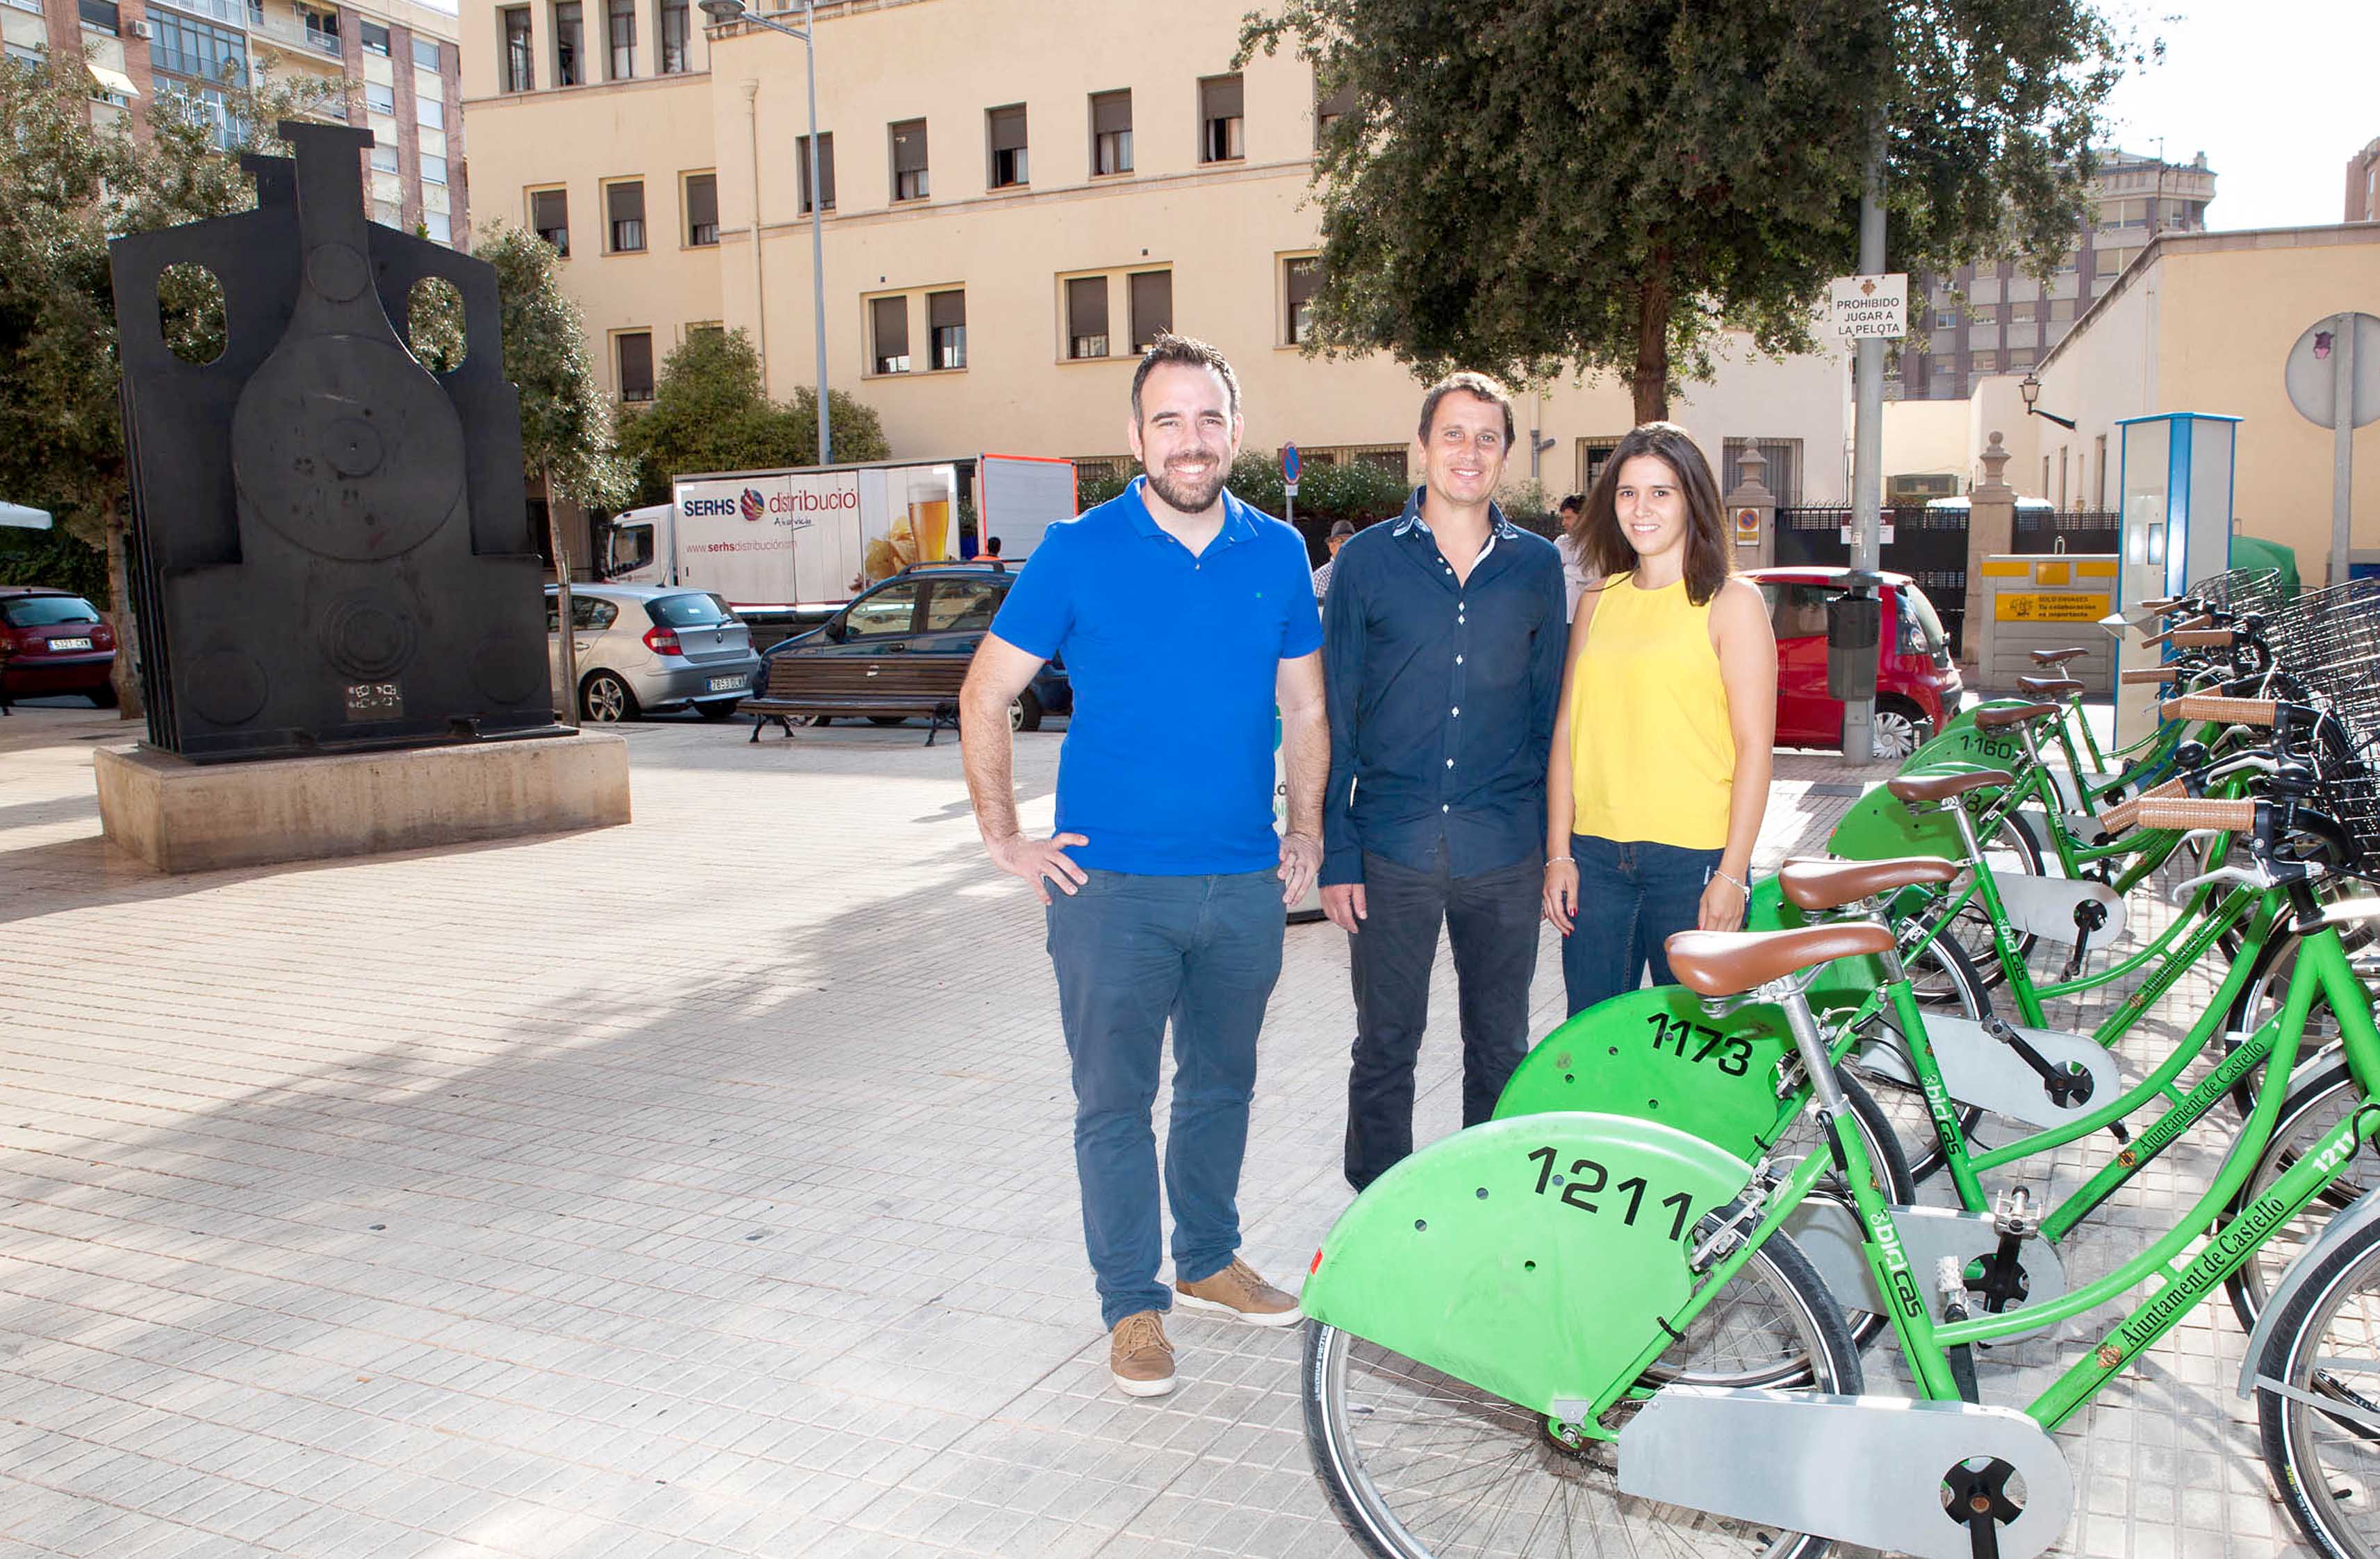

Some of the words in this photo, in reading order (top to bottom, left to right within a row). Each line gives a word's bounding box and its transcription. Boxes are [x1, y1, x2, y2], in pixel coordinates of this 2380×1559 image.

[1837, 297, 1899, 310] PROHIBIDO
[1845, 311, 1882, 322] JUGAR
[1885, 311, 1894, 320] A
[1839, 326, 1853, 335] LA
[1855, 323, 1900, 334] PELOTA
[684, 498, 735, 517] SERHS
[769, 488, 857, 513] distribució
[1960, 735, 2012, 759] 1160
[1647, 1012, 1753, 1077] 1173
[2138, 1094, 2205, 1155] Ajuntament
[2202, 1082, 2220, 1099] de
[2215, 1039, 2265, 1084] Castelló
[2313, 1132, 2355, 1173] 1211
[1527, 1146, 1693, 1242] 1211
[2121, 1267, 2208, 1347] Ajuntament
[2202, 1253, 2226, 1273] de
[2219, 1192, 2285, 1254] Castelló
